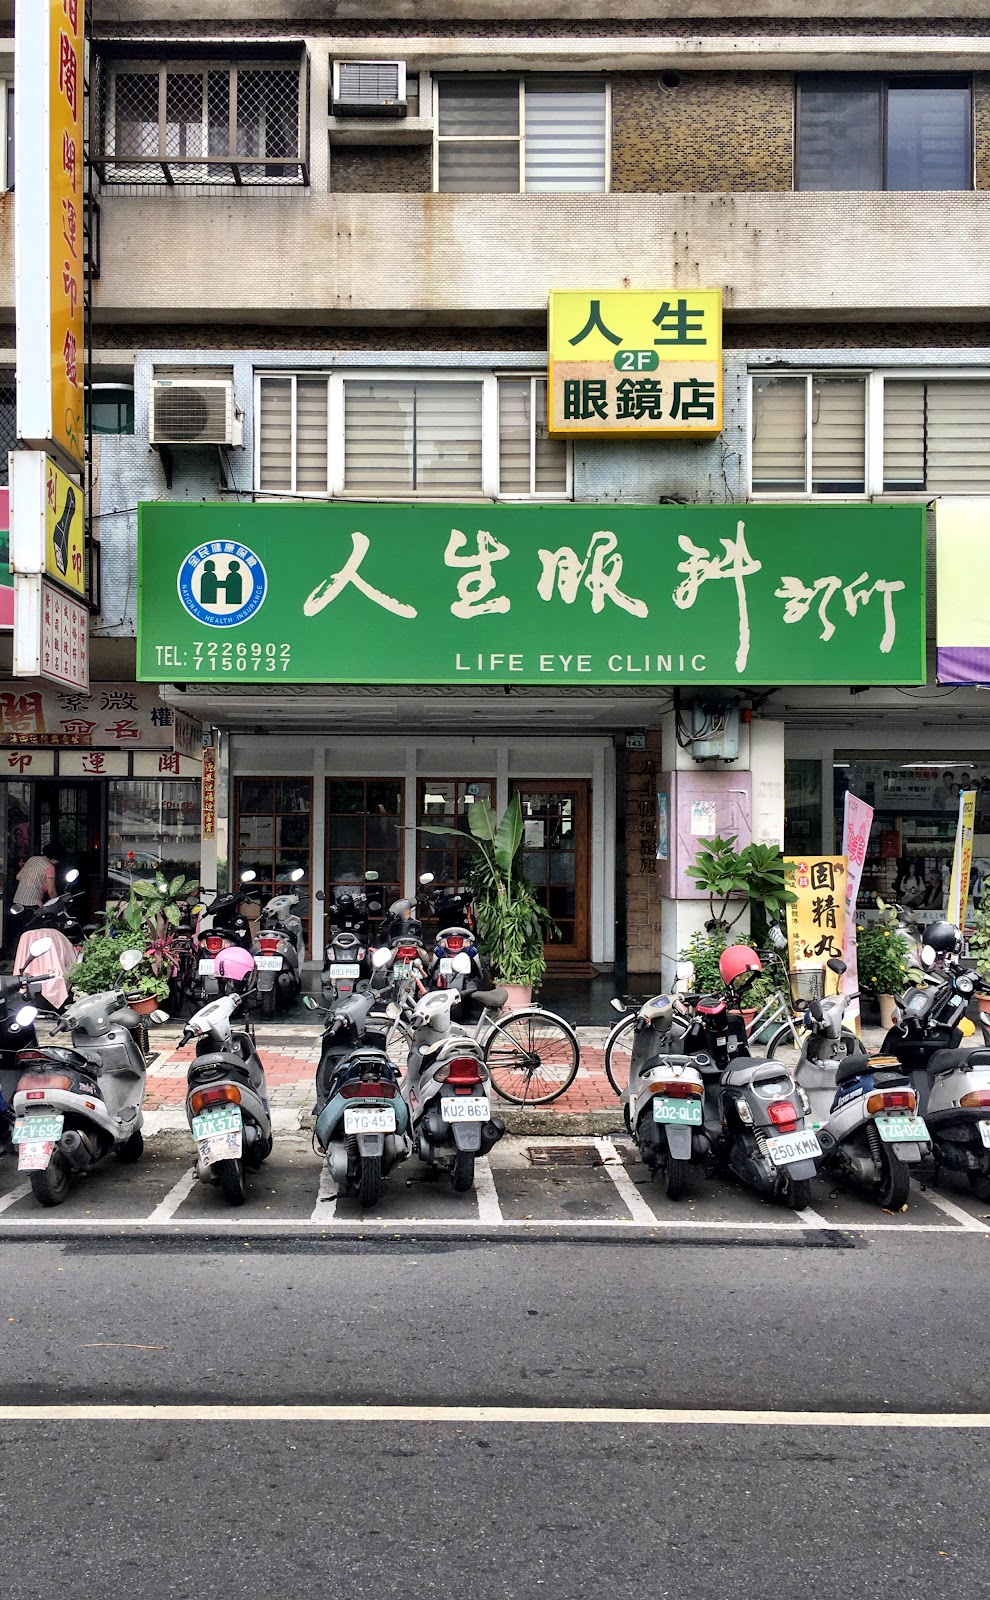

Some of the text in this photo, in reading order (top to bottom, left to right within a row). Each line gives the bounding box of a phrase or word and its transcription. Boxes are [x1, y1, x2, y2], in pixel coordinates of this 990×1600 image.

[568, 299, 708, 347] 人生
[620, 351, 652, 371] 2F
[563, 377, 716, 421] 眼鏡店
[187, 542, 257, 568] 全民健康保險
[181, 584, 263, 624] NATIONAL HEALTH INSURANCE
[156, 641, 292, 666] TEL: 7226902
[455, 653, 707, 673] LIFE EYE CLINIC
[192, 656, 292, 672] 7150737
[150, 707, 175, 726] 權
[810, 861, 842, 958] 固精丸
[443, 1105, 489, 1118] KU2-863
[654, 1105, 701, 1122] 202-QLC
[13, 1123, 61, 1139] ZEV-692
[346, 1115, 394, 1129] PYG-453
[771, 1138, 820, 1161] 250-KMN
